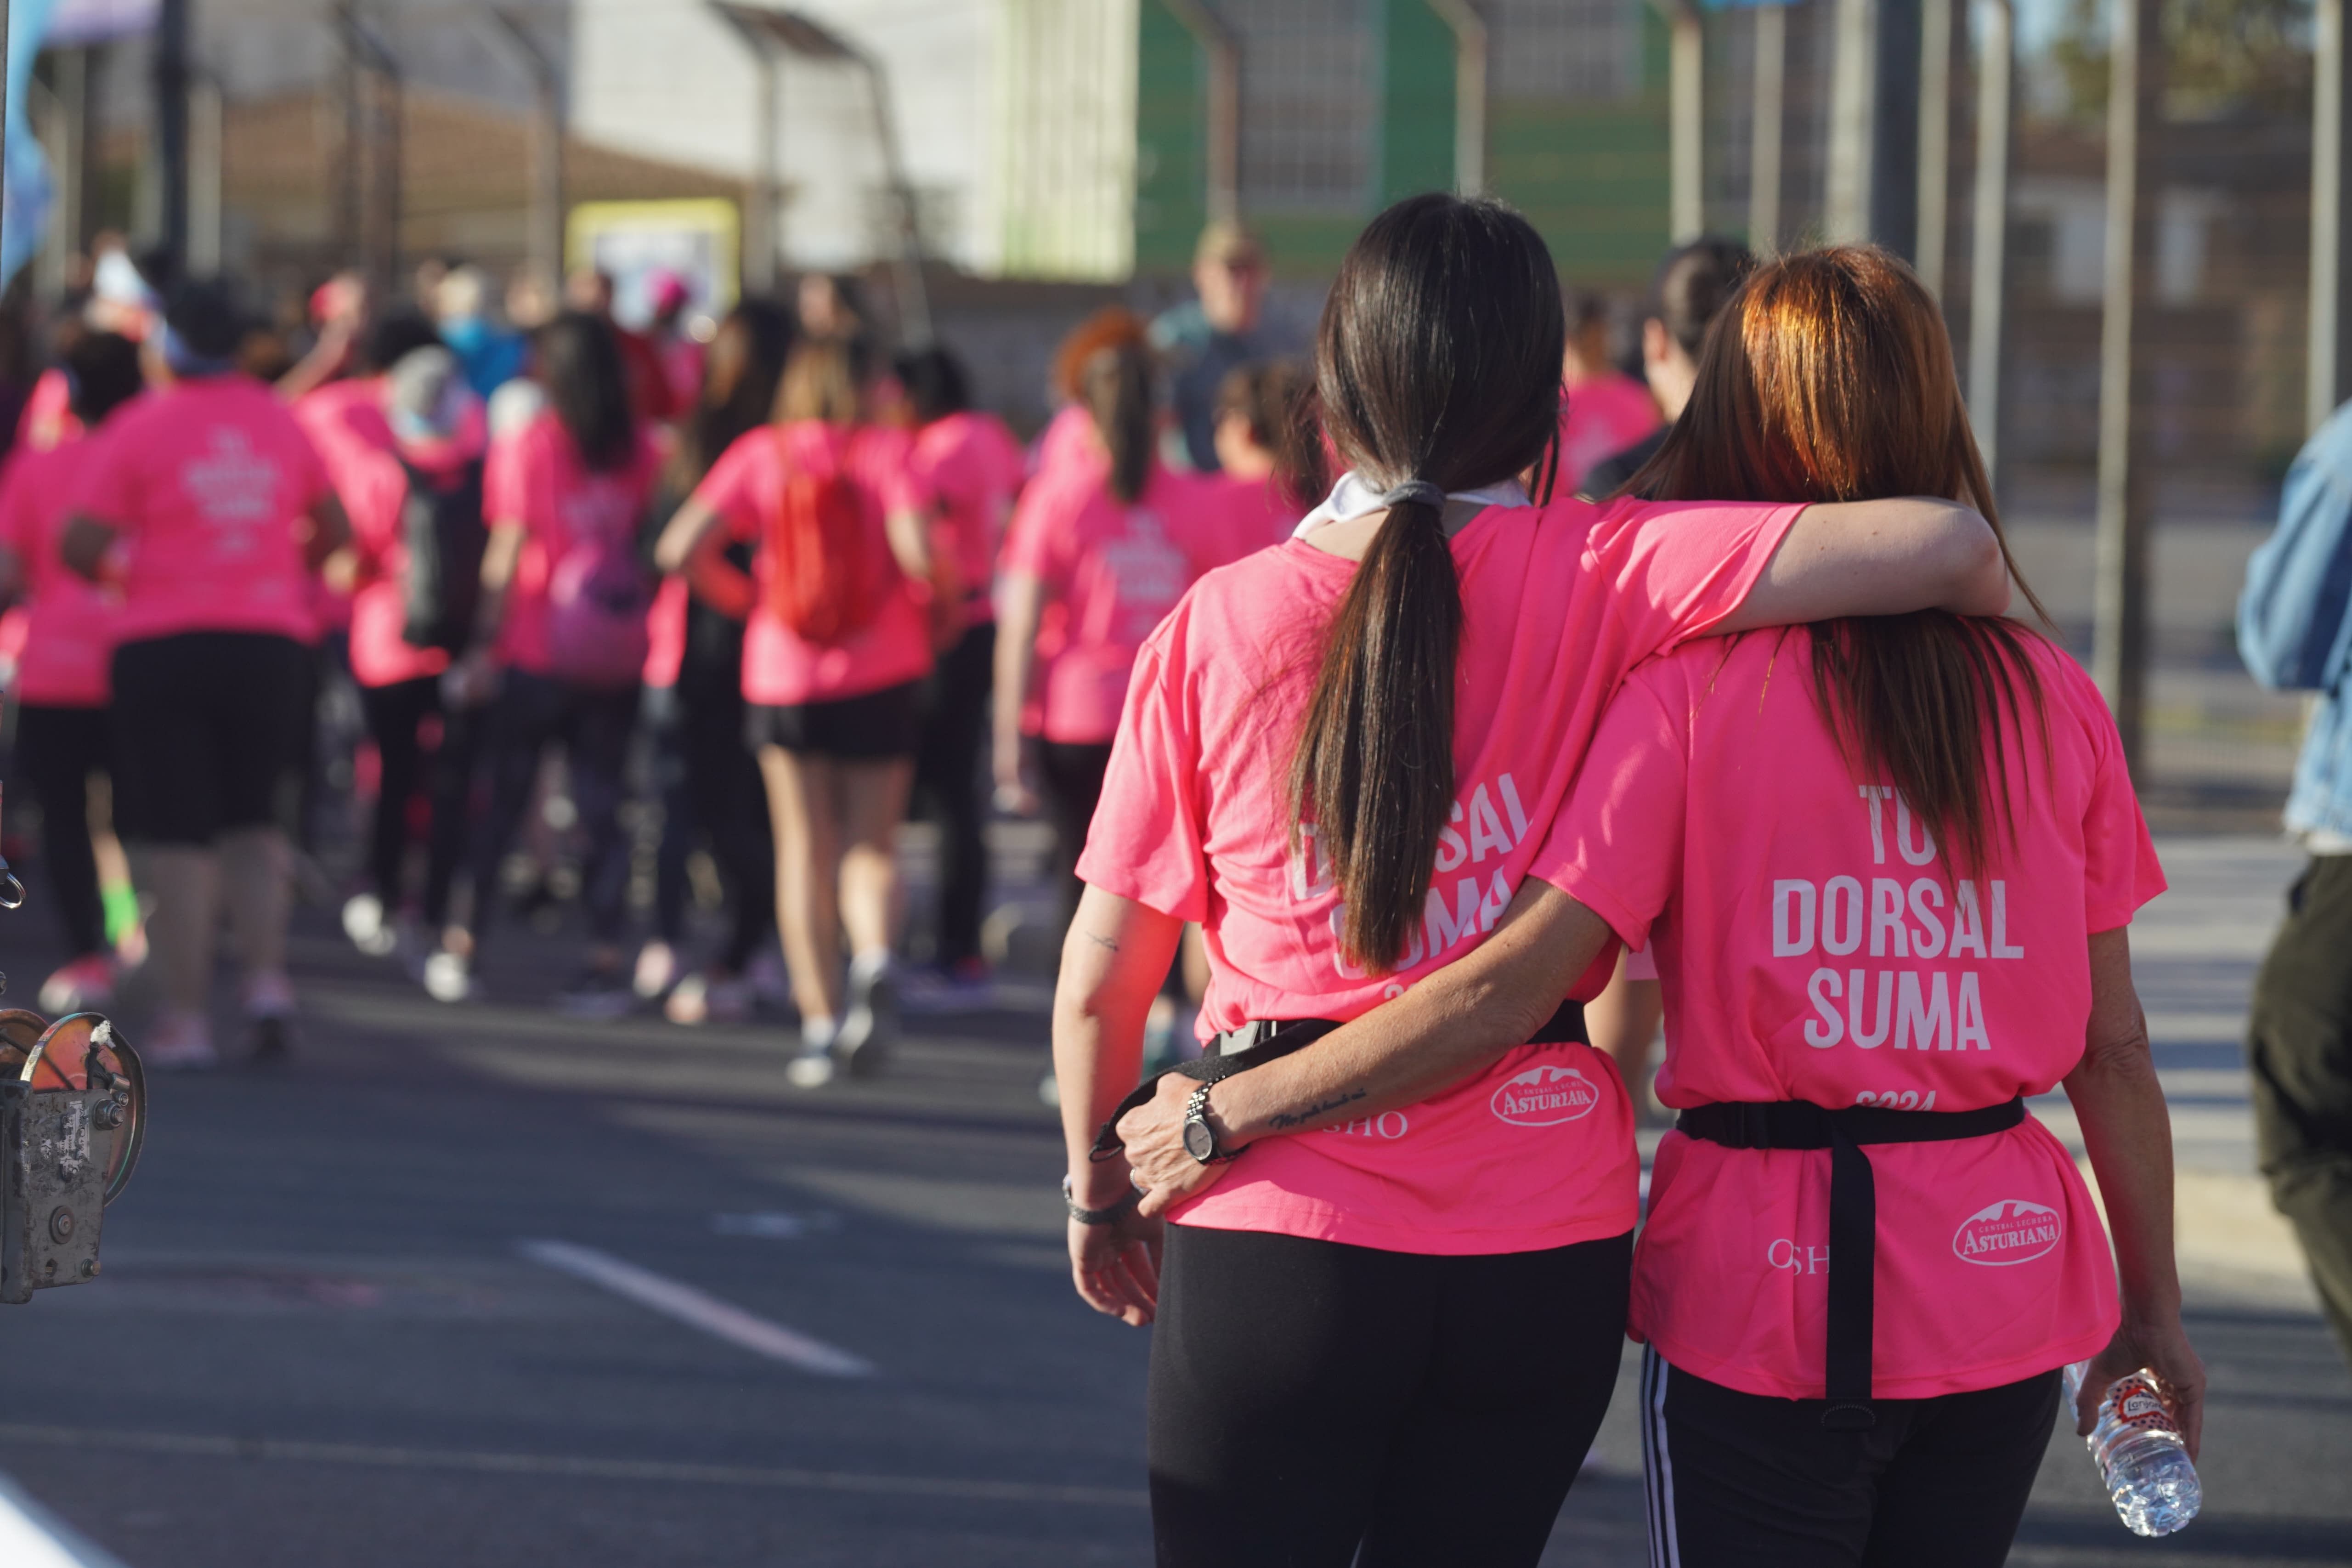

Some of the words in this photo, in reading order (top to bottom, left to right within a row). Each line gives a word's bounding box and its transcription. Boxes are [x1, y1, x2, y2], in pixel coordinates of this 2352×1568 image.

[1859, 785, 1937, 866] TU
[1772, 875, 2024, 959] DORSAL
[1804, 967, 1991, 1051] SUMA
[1963, 1224, 2057, 1256] ASTURIANA
[1979, 1223, 2014, 1233] CENTRAL
[2017, 1215, 2053, 1228] LECHERA
[1768, 1238, 1830, 1276] OSH
